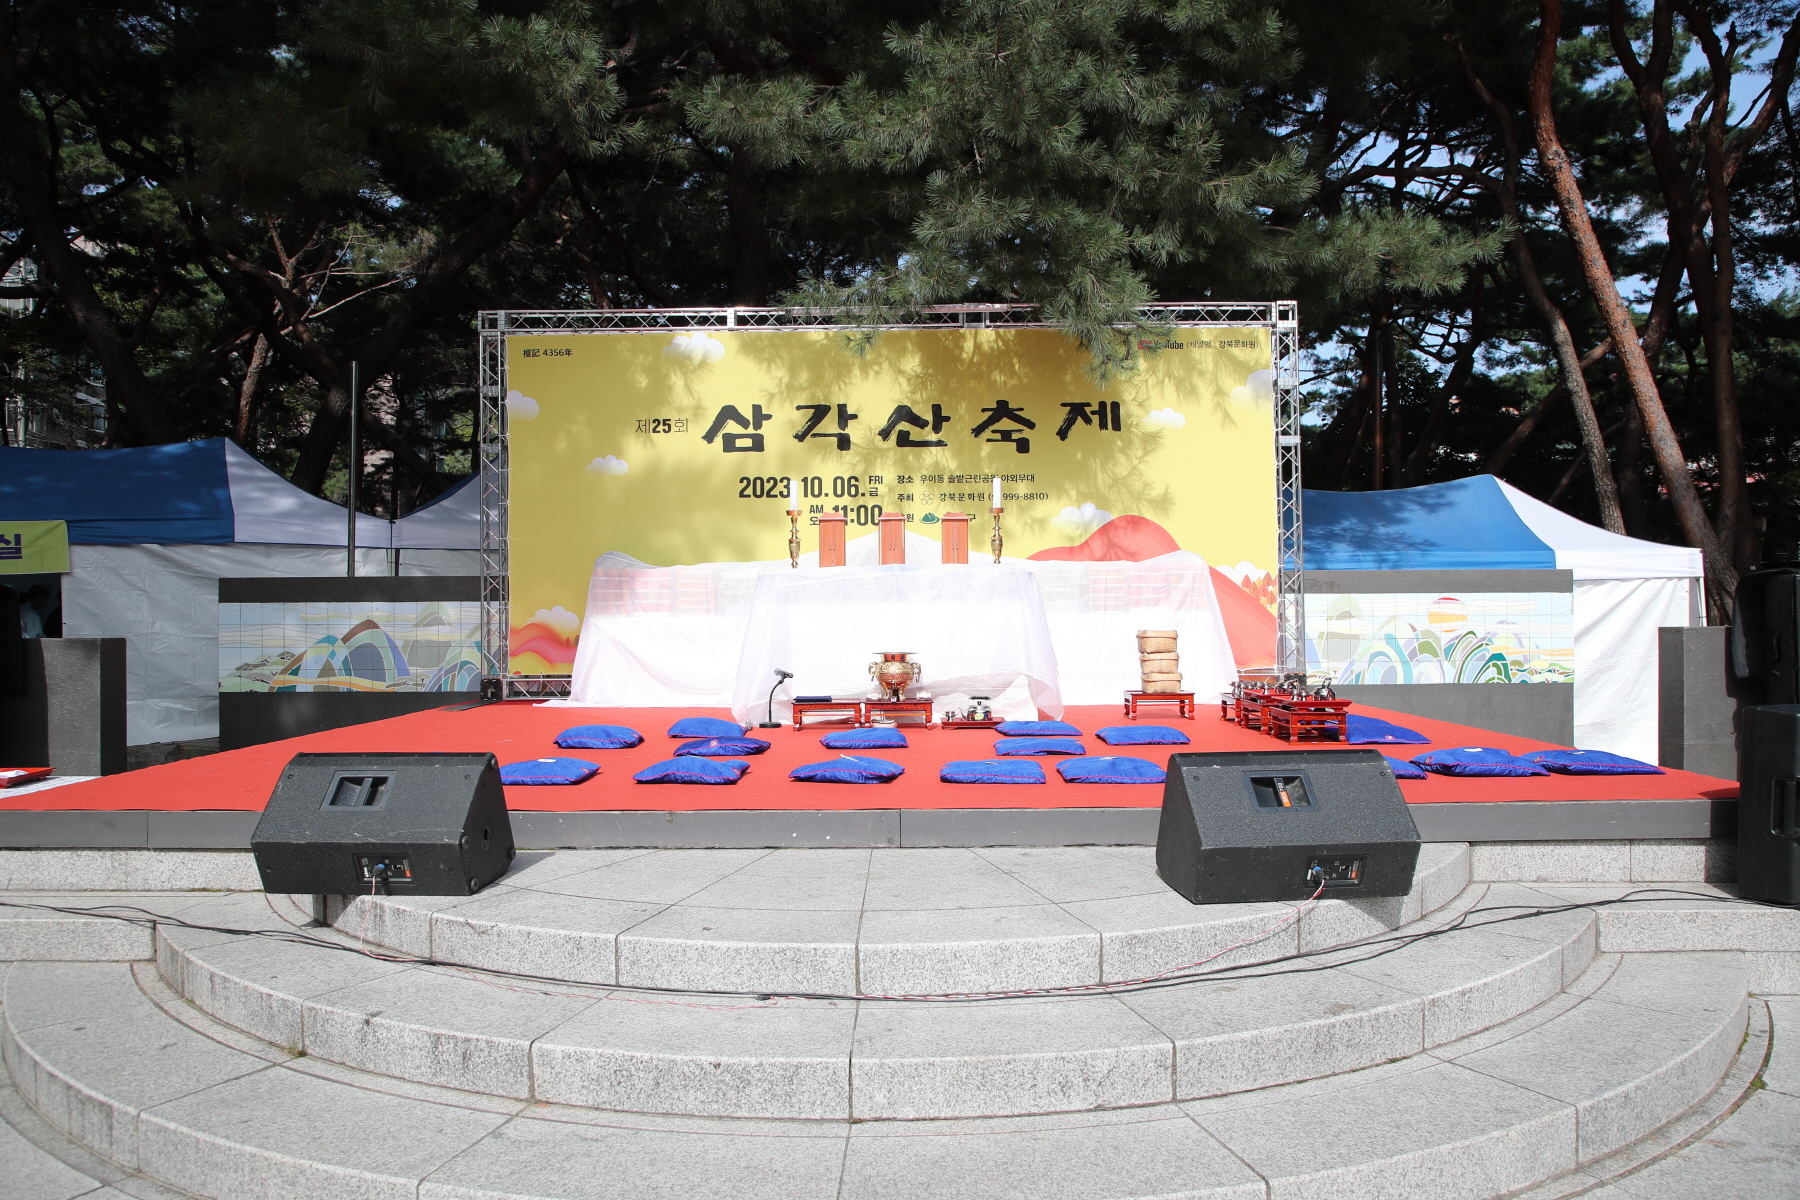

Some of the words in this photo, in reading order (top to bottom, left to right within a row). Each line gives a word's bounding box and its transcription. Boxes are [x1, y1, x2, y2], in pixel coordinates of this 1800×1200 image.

[635, 418, 689, 434] 제25회
[868, 475, 883, 485] FRI
[896, 474, 914, 484] 장소
[919, 474, 945, 484] 우이동
[1001, 474, 1035, 483] 야외무대
[868, 486, 879, 497] 금
[809, 504, 824, 514] AM
